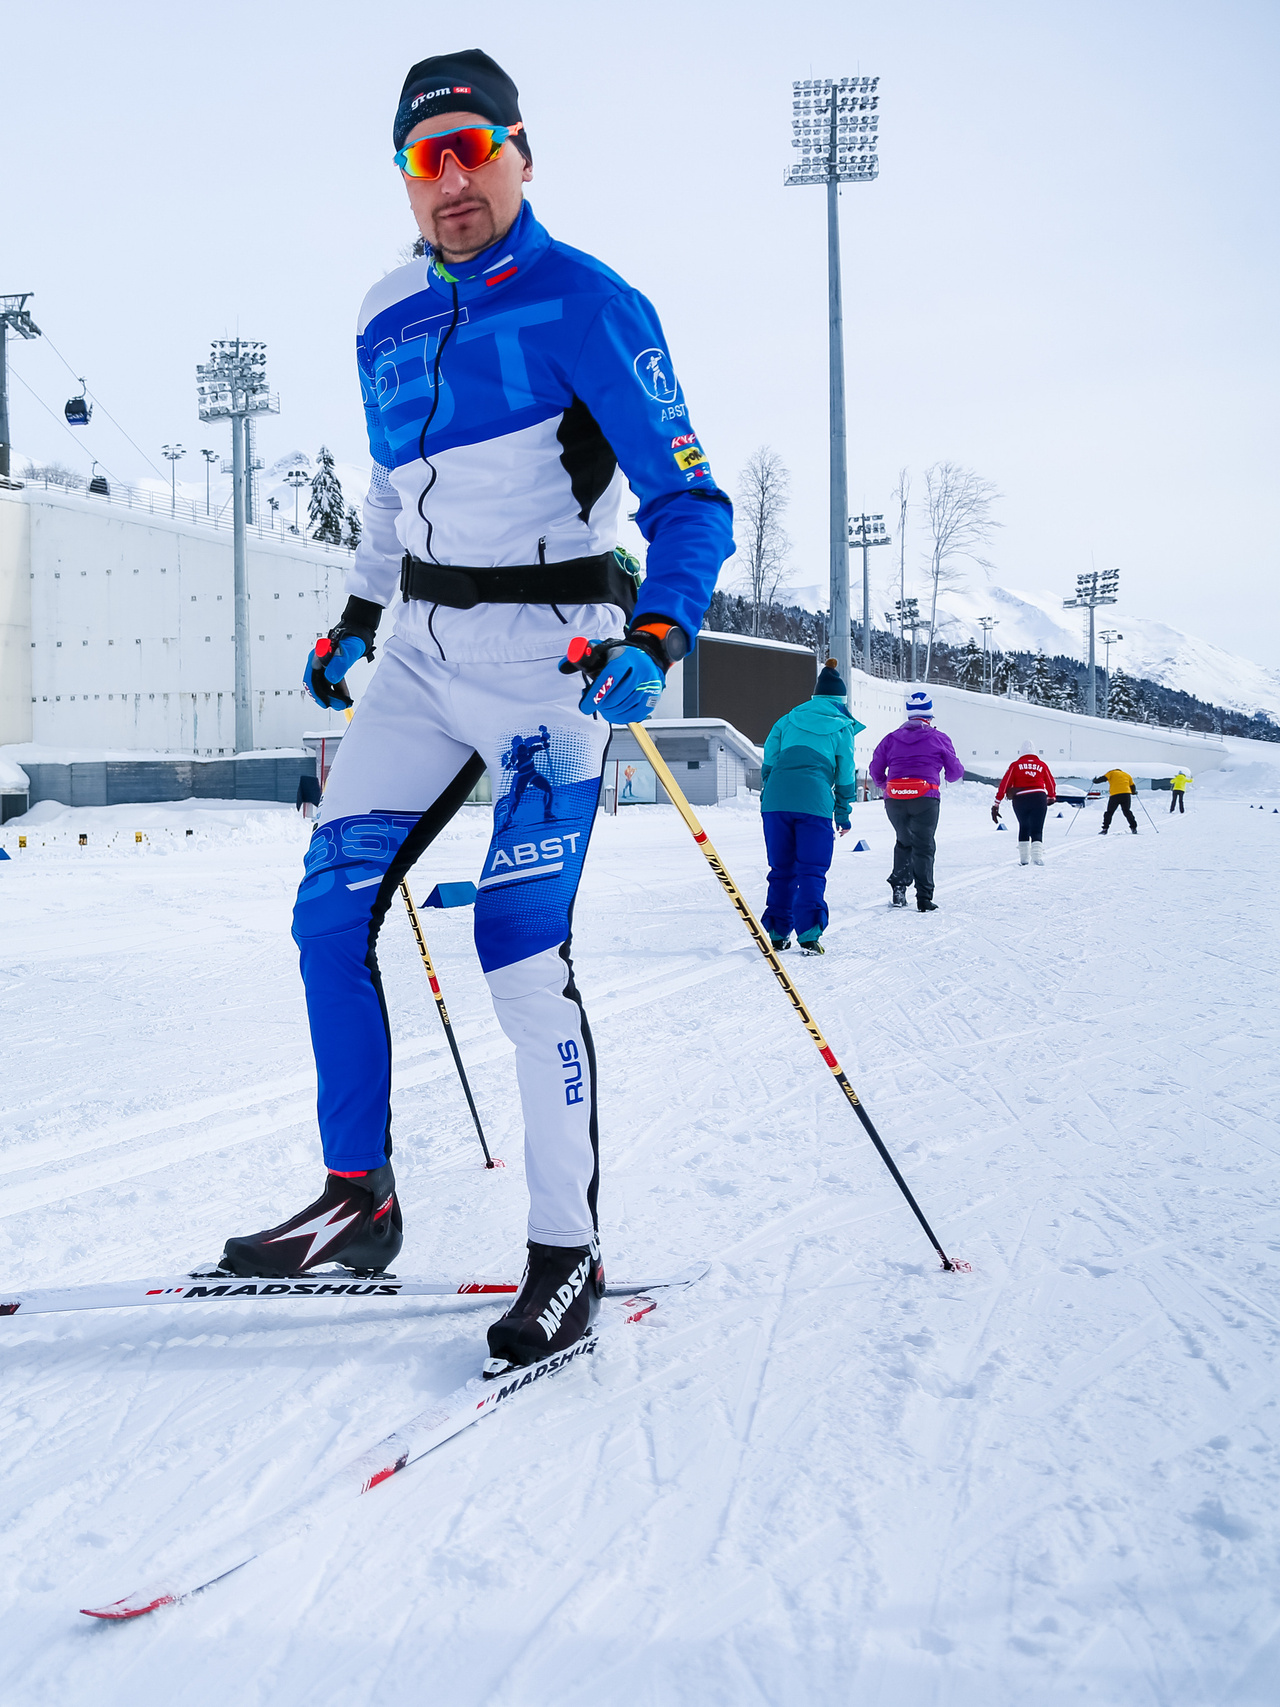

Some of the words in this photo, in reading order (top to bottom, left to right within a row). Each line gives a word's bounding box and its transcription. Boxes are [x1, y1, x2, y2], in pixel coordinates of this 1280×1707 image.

[411, 87, 451, 111] grom
[661, 403, 686, 422] ABST
[1018, 763, 1043, 773] RUSSIA
[490, 832, 581, 872] ABST
[557, 1039, 584, 1106] RUS
[182, 1284, 403, 1299] MADSHUS
[495, 1336, 600, 1404] MADSHUS
